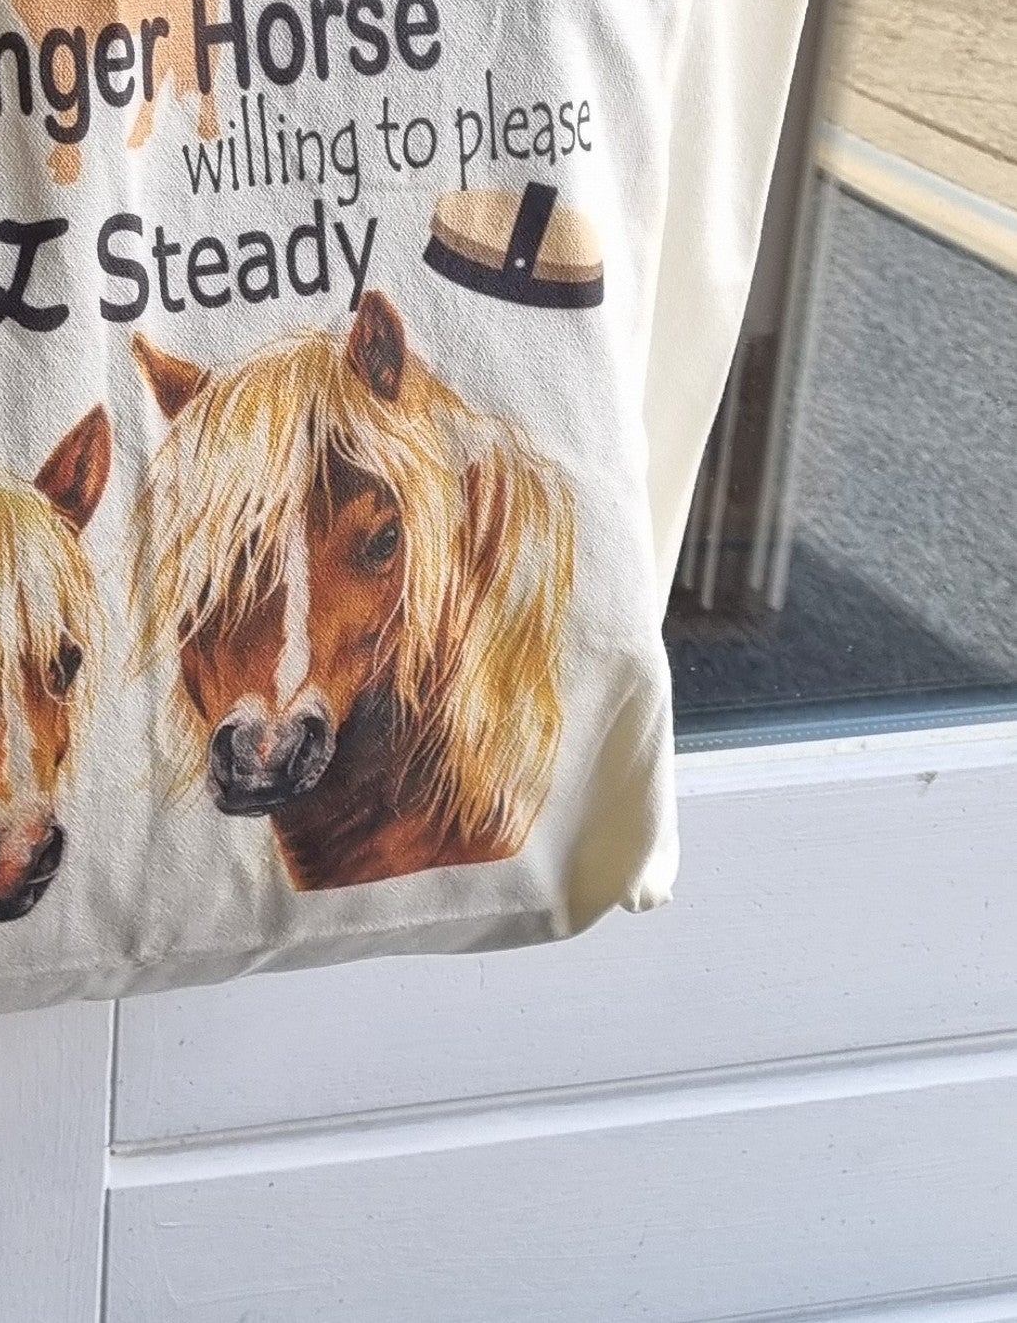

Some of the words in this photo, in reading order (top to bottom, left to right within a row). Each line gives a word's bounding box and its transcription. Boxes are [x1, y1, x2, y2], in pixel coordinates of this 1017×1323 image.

[182, 92, 361, 207] willing
[376, 97, 438, 173] to
[456, 70, 593, 191] please
[97, 199, 378, 324] Steady
